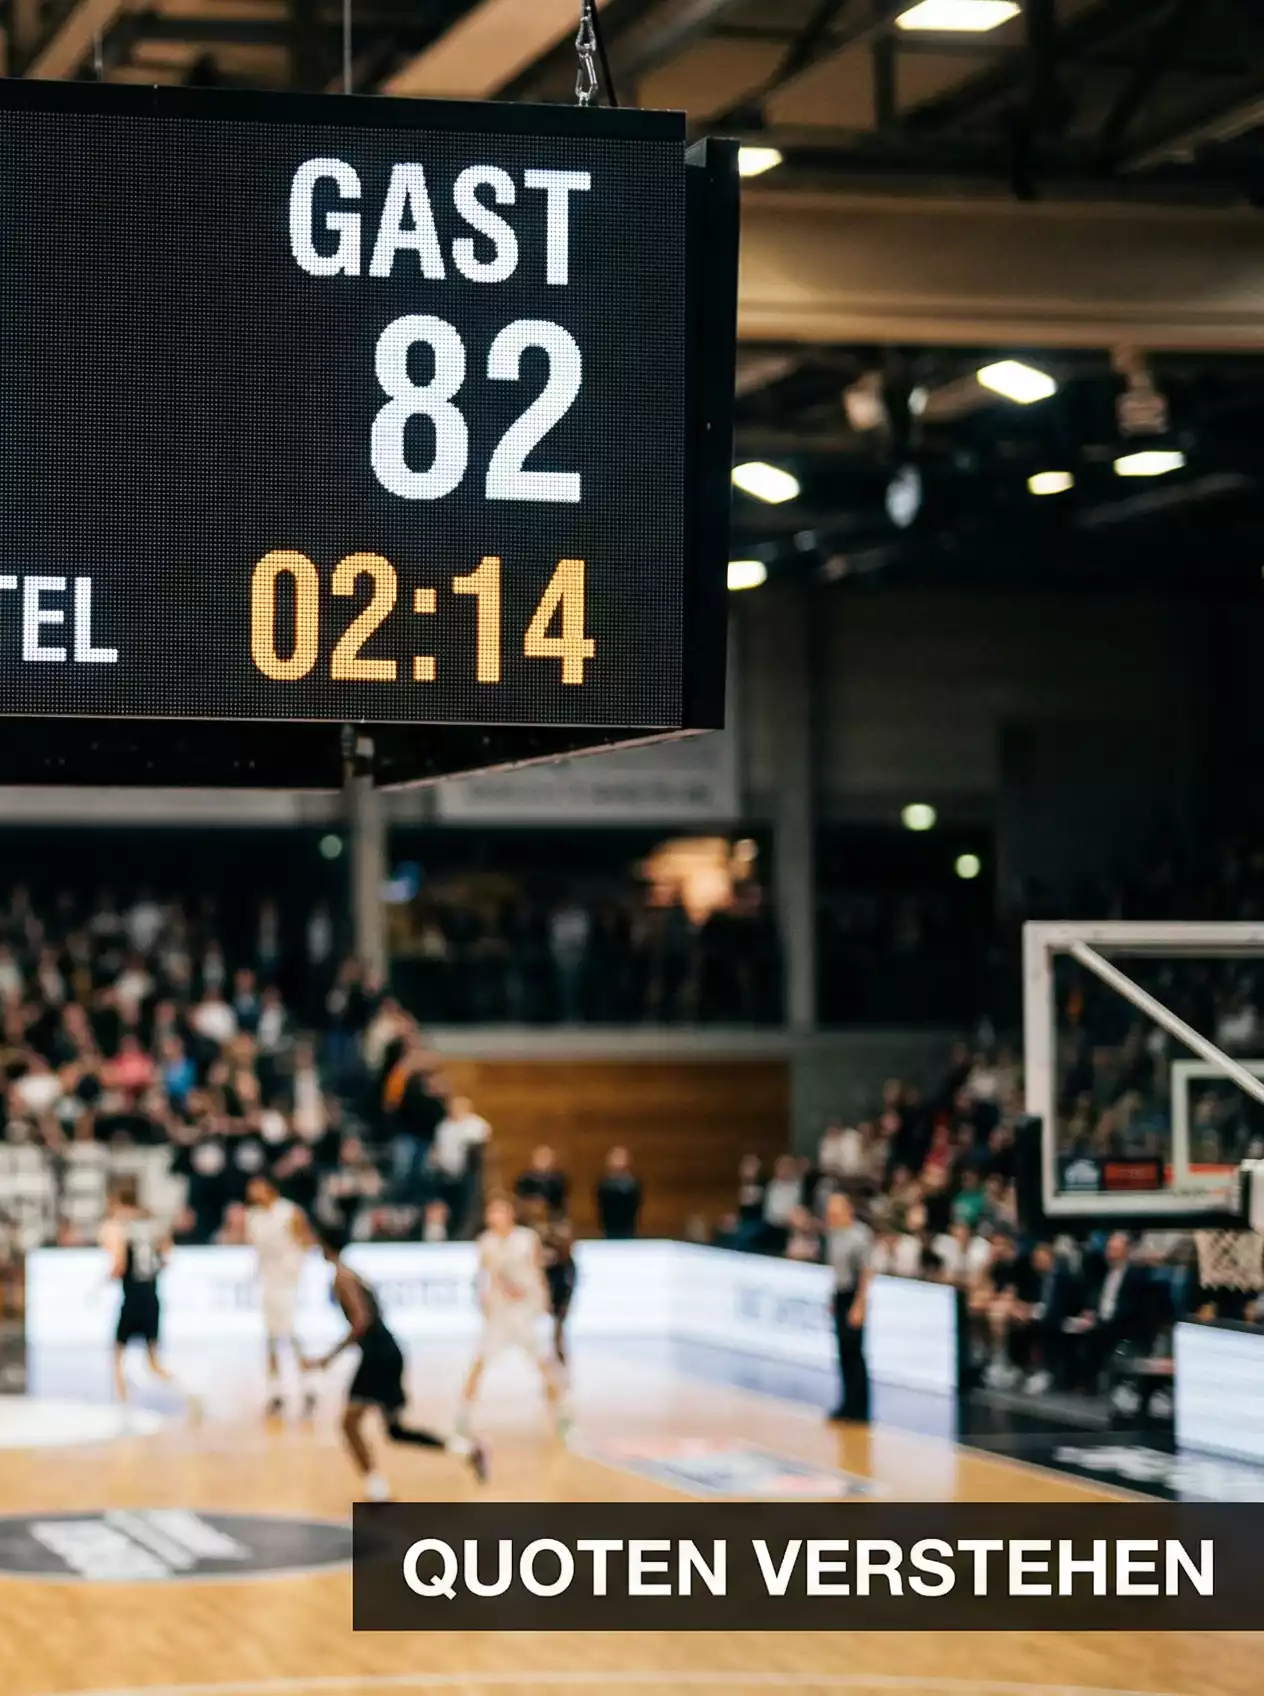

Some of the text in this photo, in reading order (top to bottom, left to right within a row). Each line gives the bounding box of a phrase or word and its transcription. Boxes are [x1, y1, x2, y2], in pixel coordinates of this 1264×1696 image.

[288, 157, 593, 286] GAST
[369, 313, 584, 504] 82
[249, 549, 596, 686] 02:14
